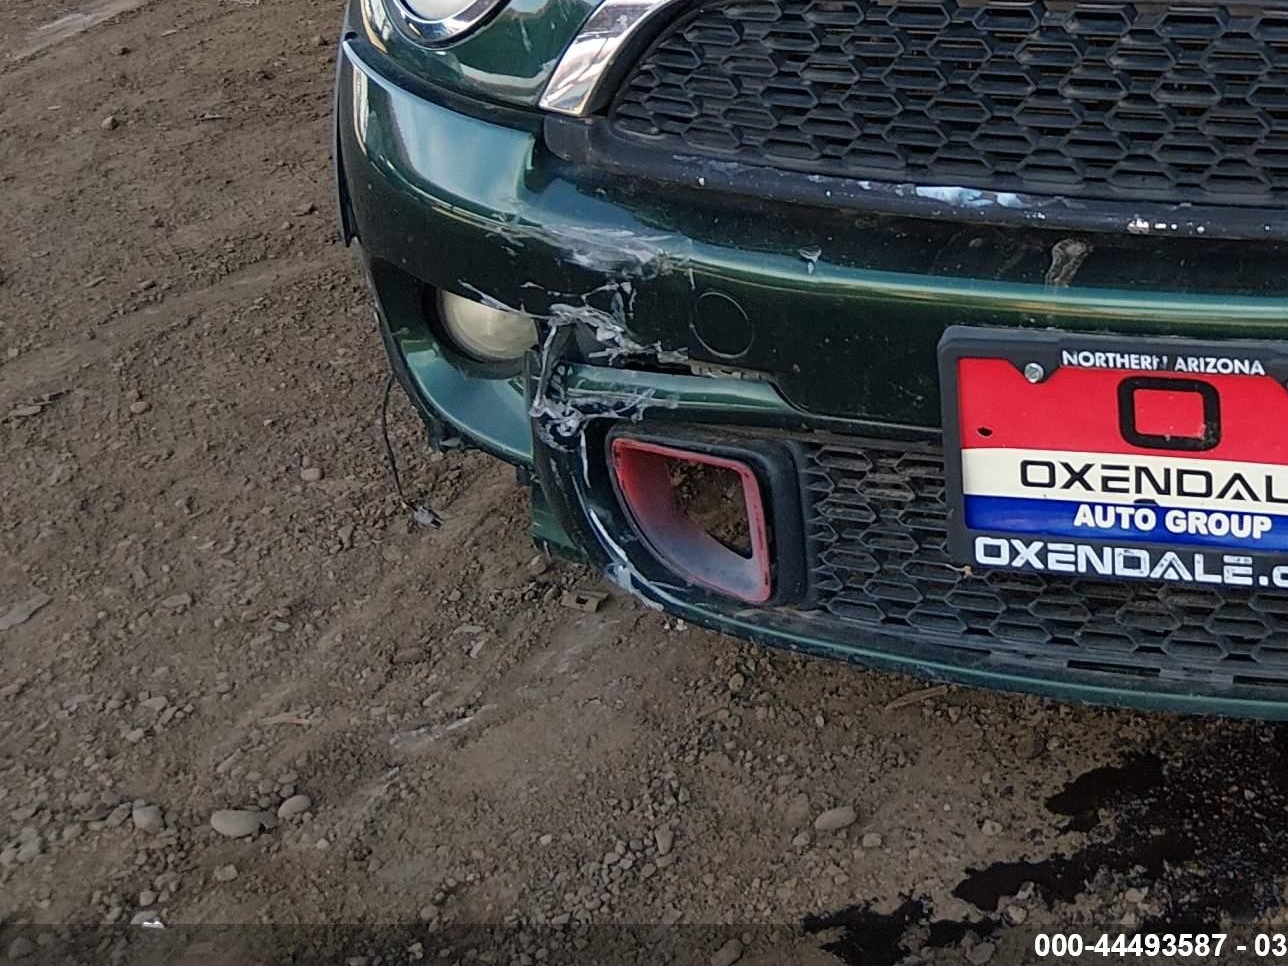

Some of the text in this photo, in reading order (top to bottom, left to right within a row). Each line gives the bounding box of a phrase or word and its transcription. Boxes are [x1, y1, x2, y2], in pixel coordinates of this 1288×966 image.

[1174, 356, 1266, 376] ARIZONA
[1073, 504, 1273, 539] AUTO GROUP
